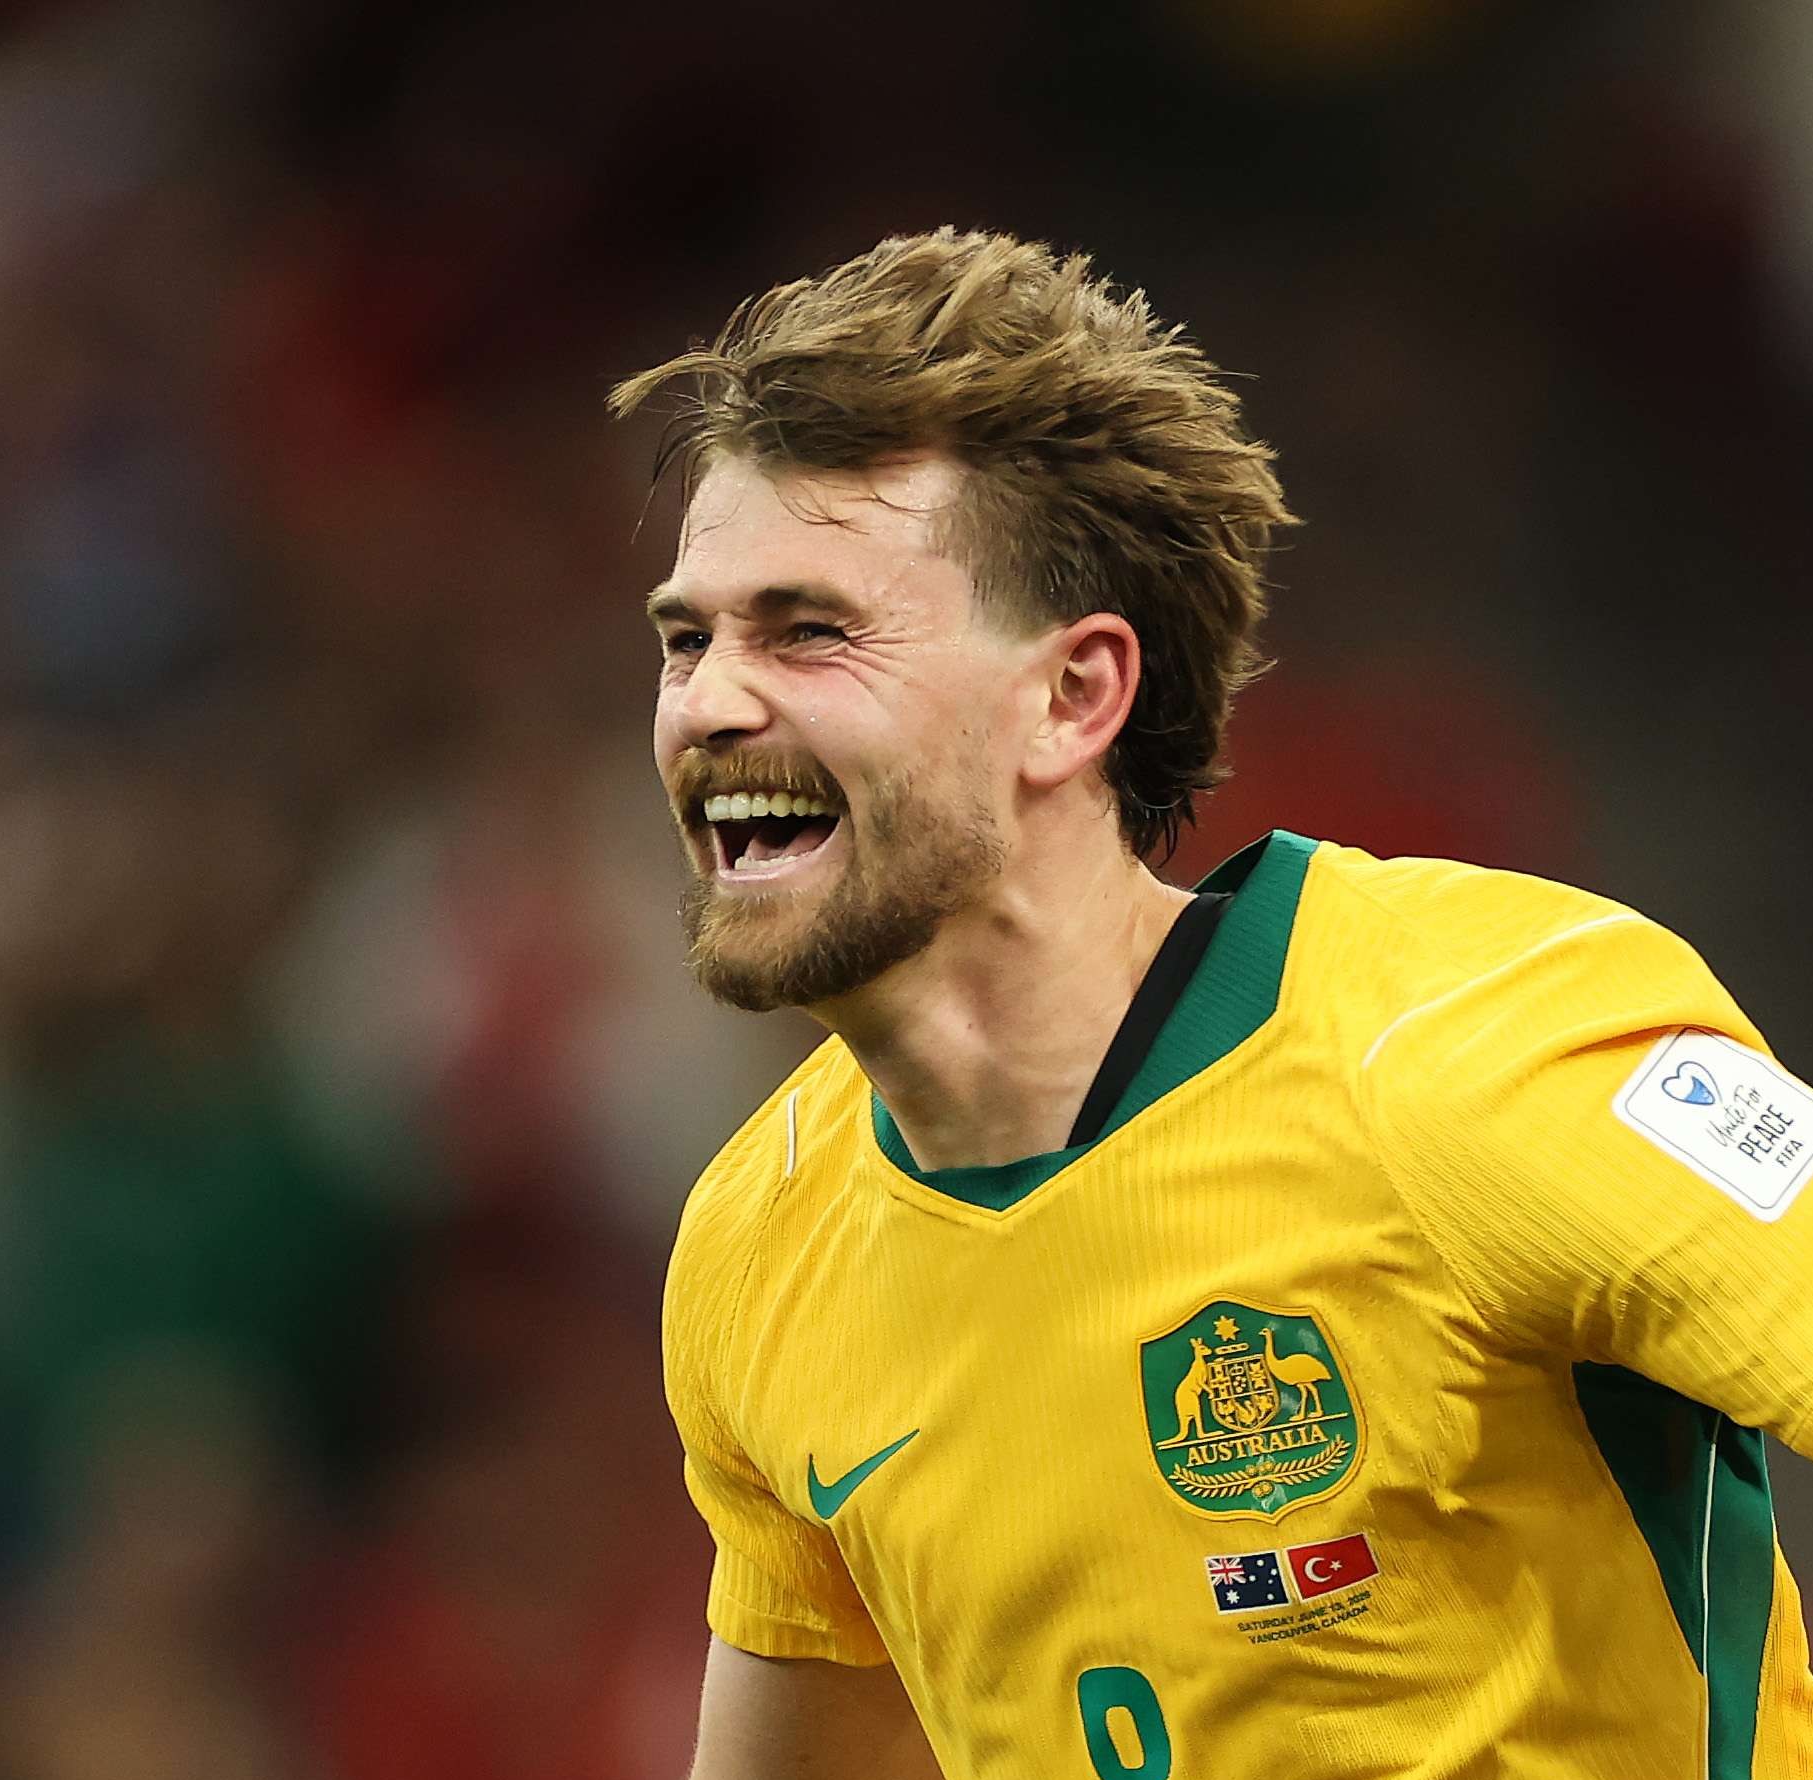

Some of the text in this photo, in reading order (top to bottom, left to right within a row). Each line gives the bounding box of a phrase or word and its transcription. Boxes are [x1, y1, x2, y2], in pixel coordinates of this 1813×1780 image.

[1707, 1085, 1762, 1147] Unite For
[1737, 1104, 1794, 1163] PEACE
[1776, 1139, 1803, 1168] FIFA
[1186, 1424, 1329, 1468] AUSTRALIA
[1238, 1615, 1294, 1632] SATURDAY
[1322, 1605, 1369, 1628] CANADA
